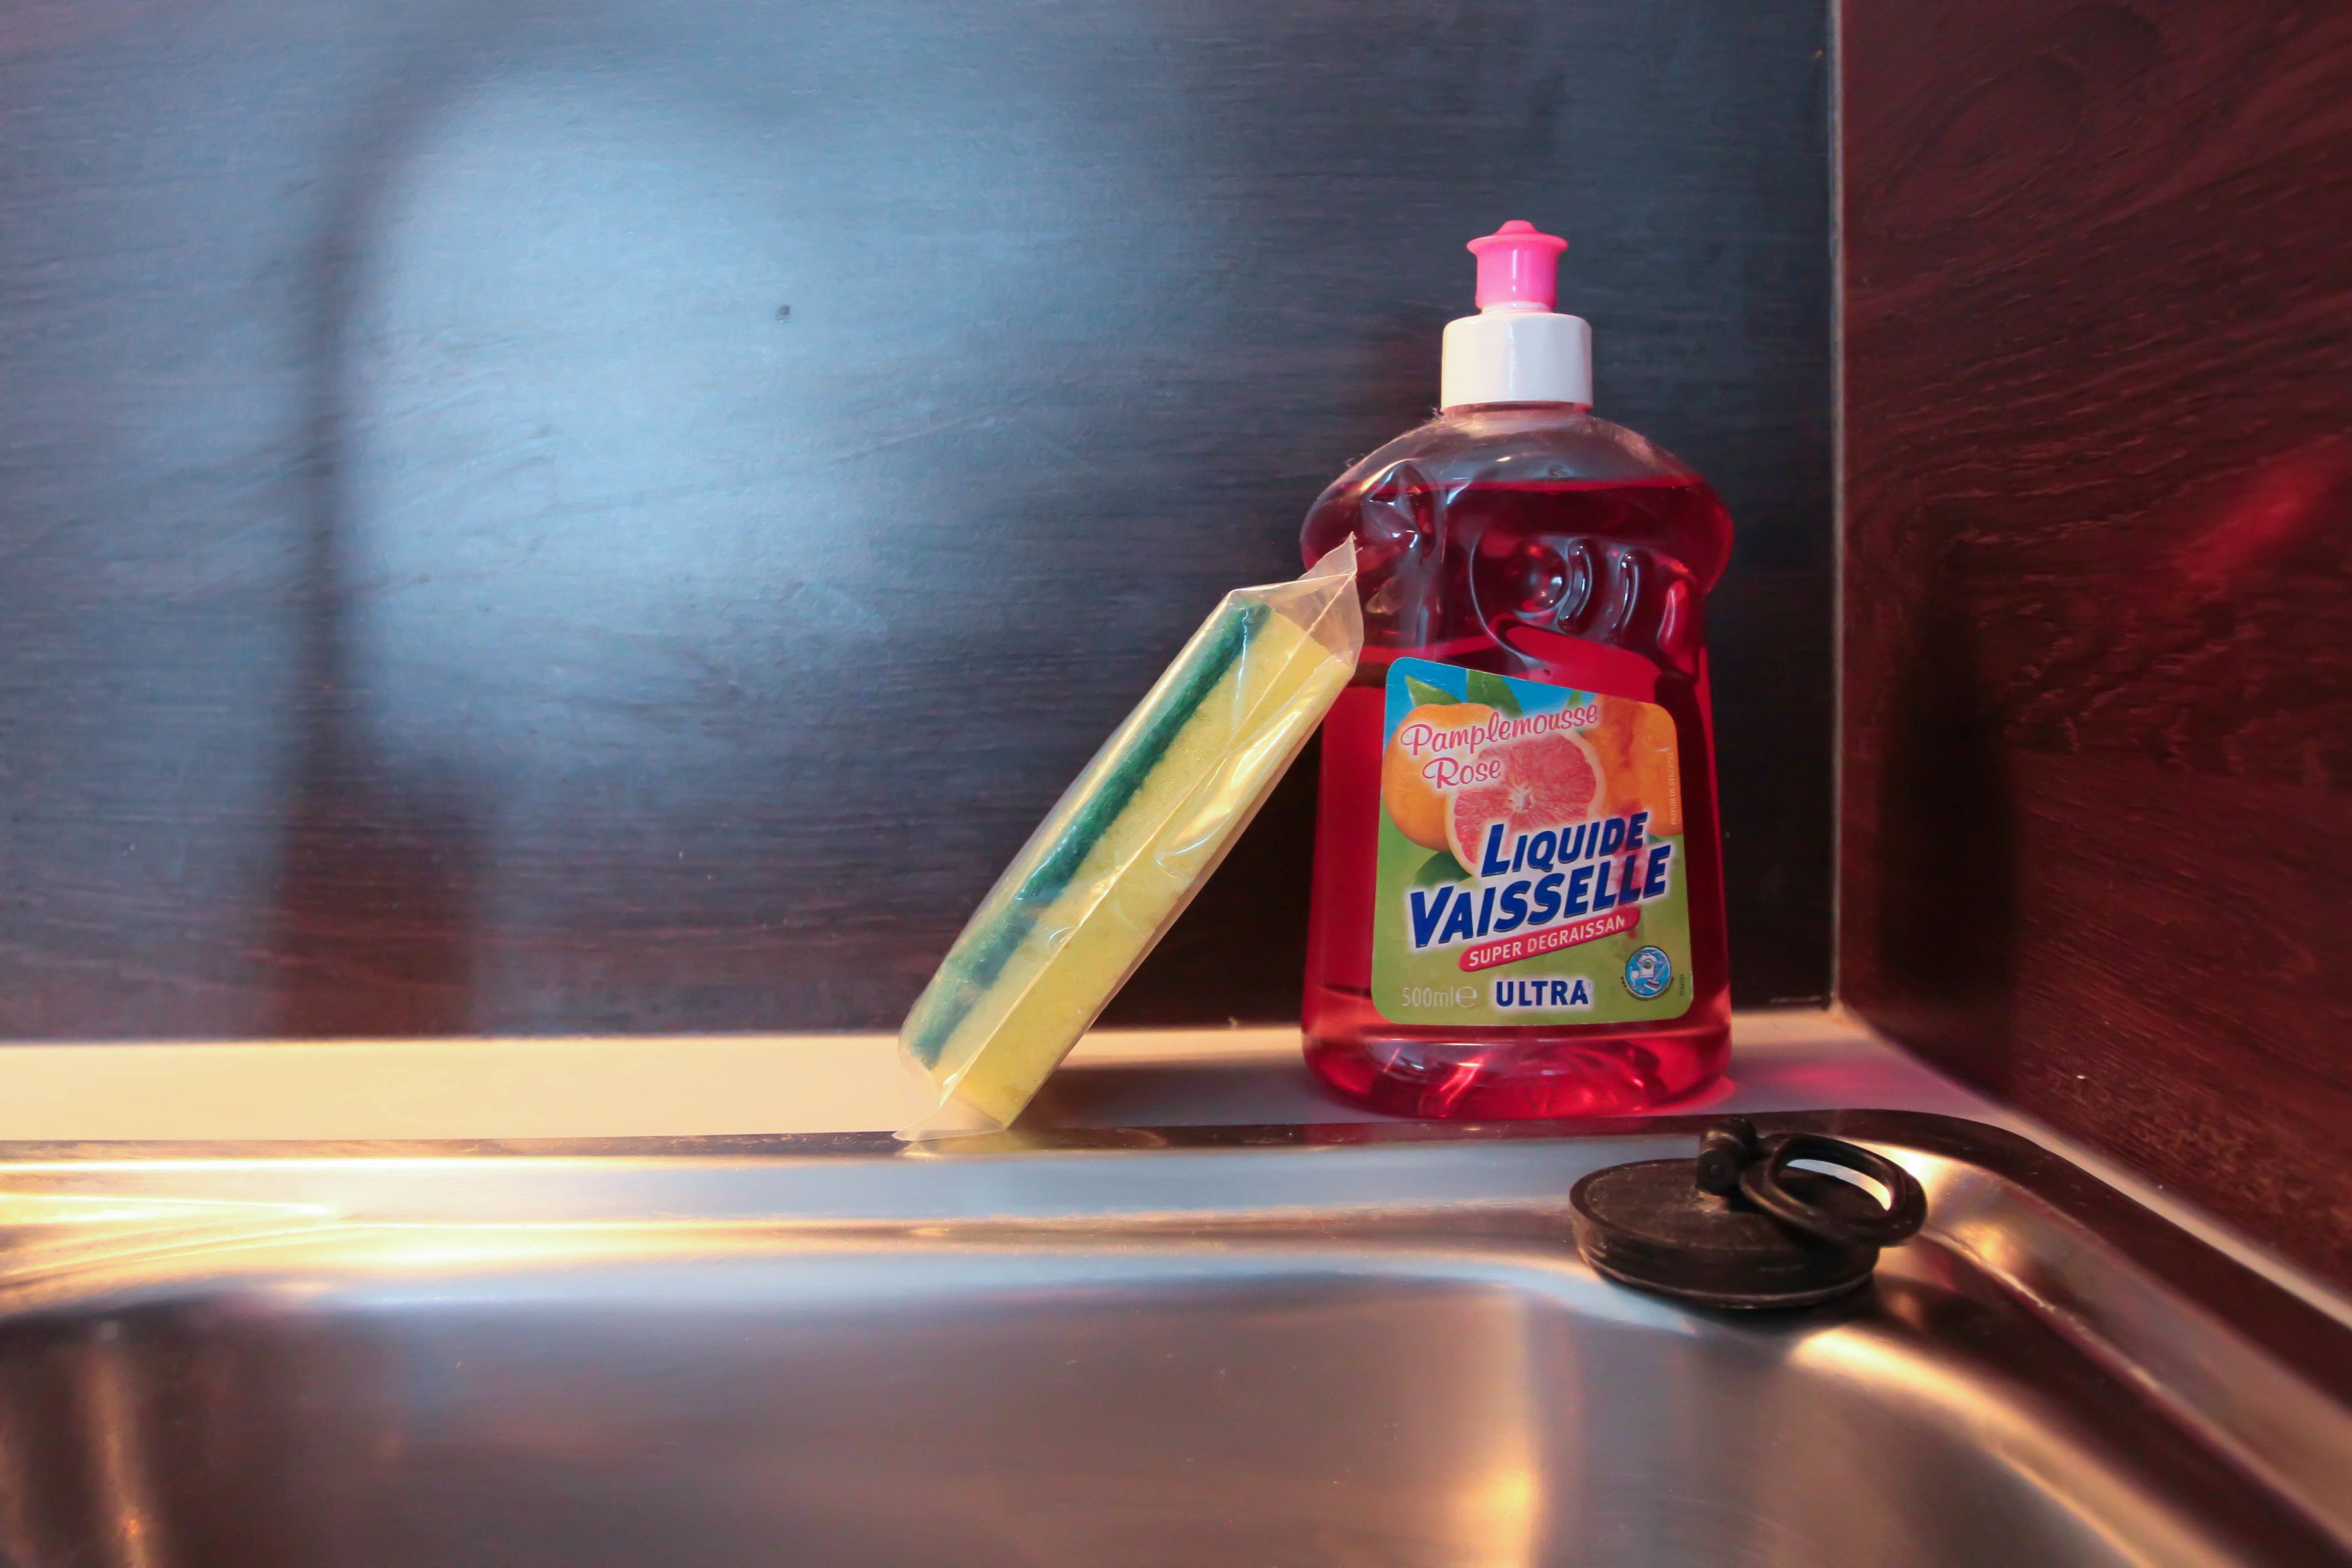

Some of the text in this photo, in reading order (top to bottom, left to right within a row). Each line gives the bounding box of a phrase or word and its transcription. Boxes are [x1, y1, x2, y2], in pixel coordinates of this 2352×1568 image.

[1401, 704, 1597, 755] Pamplemousse
[1422, 757, 1500, 789] Rose
[1481, 812, 1648, 878] LIQUIDE
[1410, 844, 1672, 949] VAISSELLE
[1469, 941, 1522, 967] SUPER
[1496, 980, 1589, 1008] ULTRA
